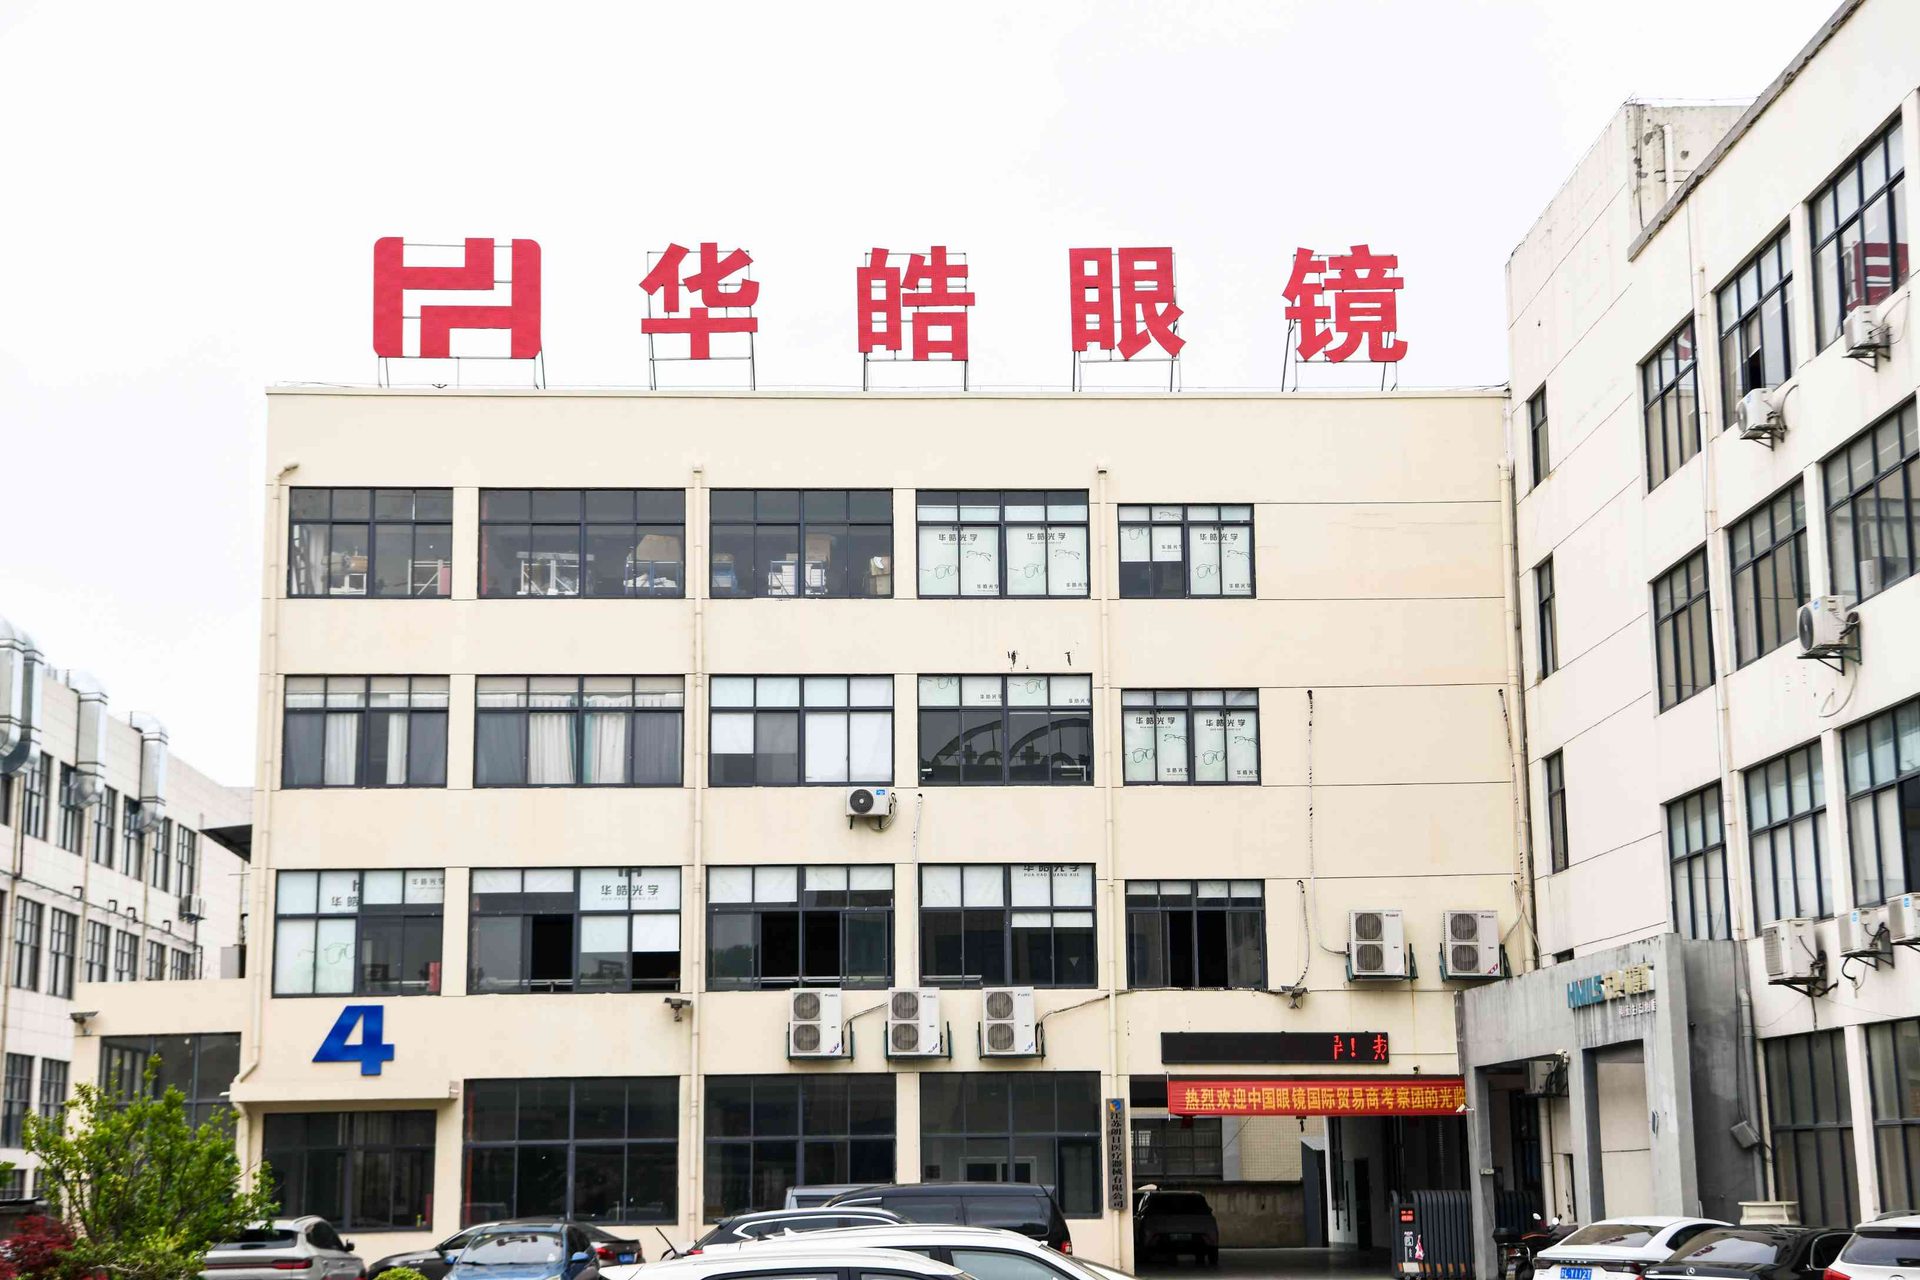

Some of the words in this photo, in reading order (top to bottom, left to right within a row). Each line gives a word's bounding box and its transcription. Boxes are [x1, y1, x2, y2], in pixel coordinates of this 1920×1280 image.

[640, 242, 1408, 362] 华皓眼镜
[601, 884, 659, 896] 华皓光学
[312, 1004, 394, 1076] 4
